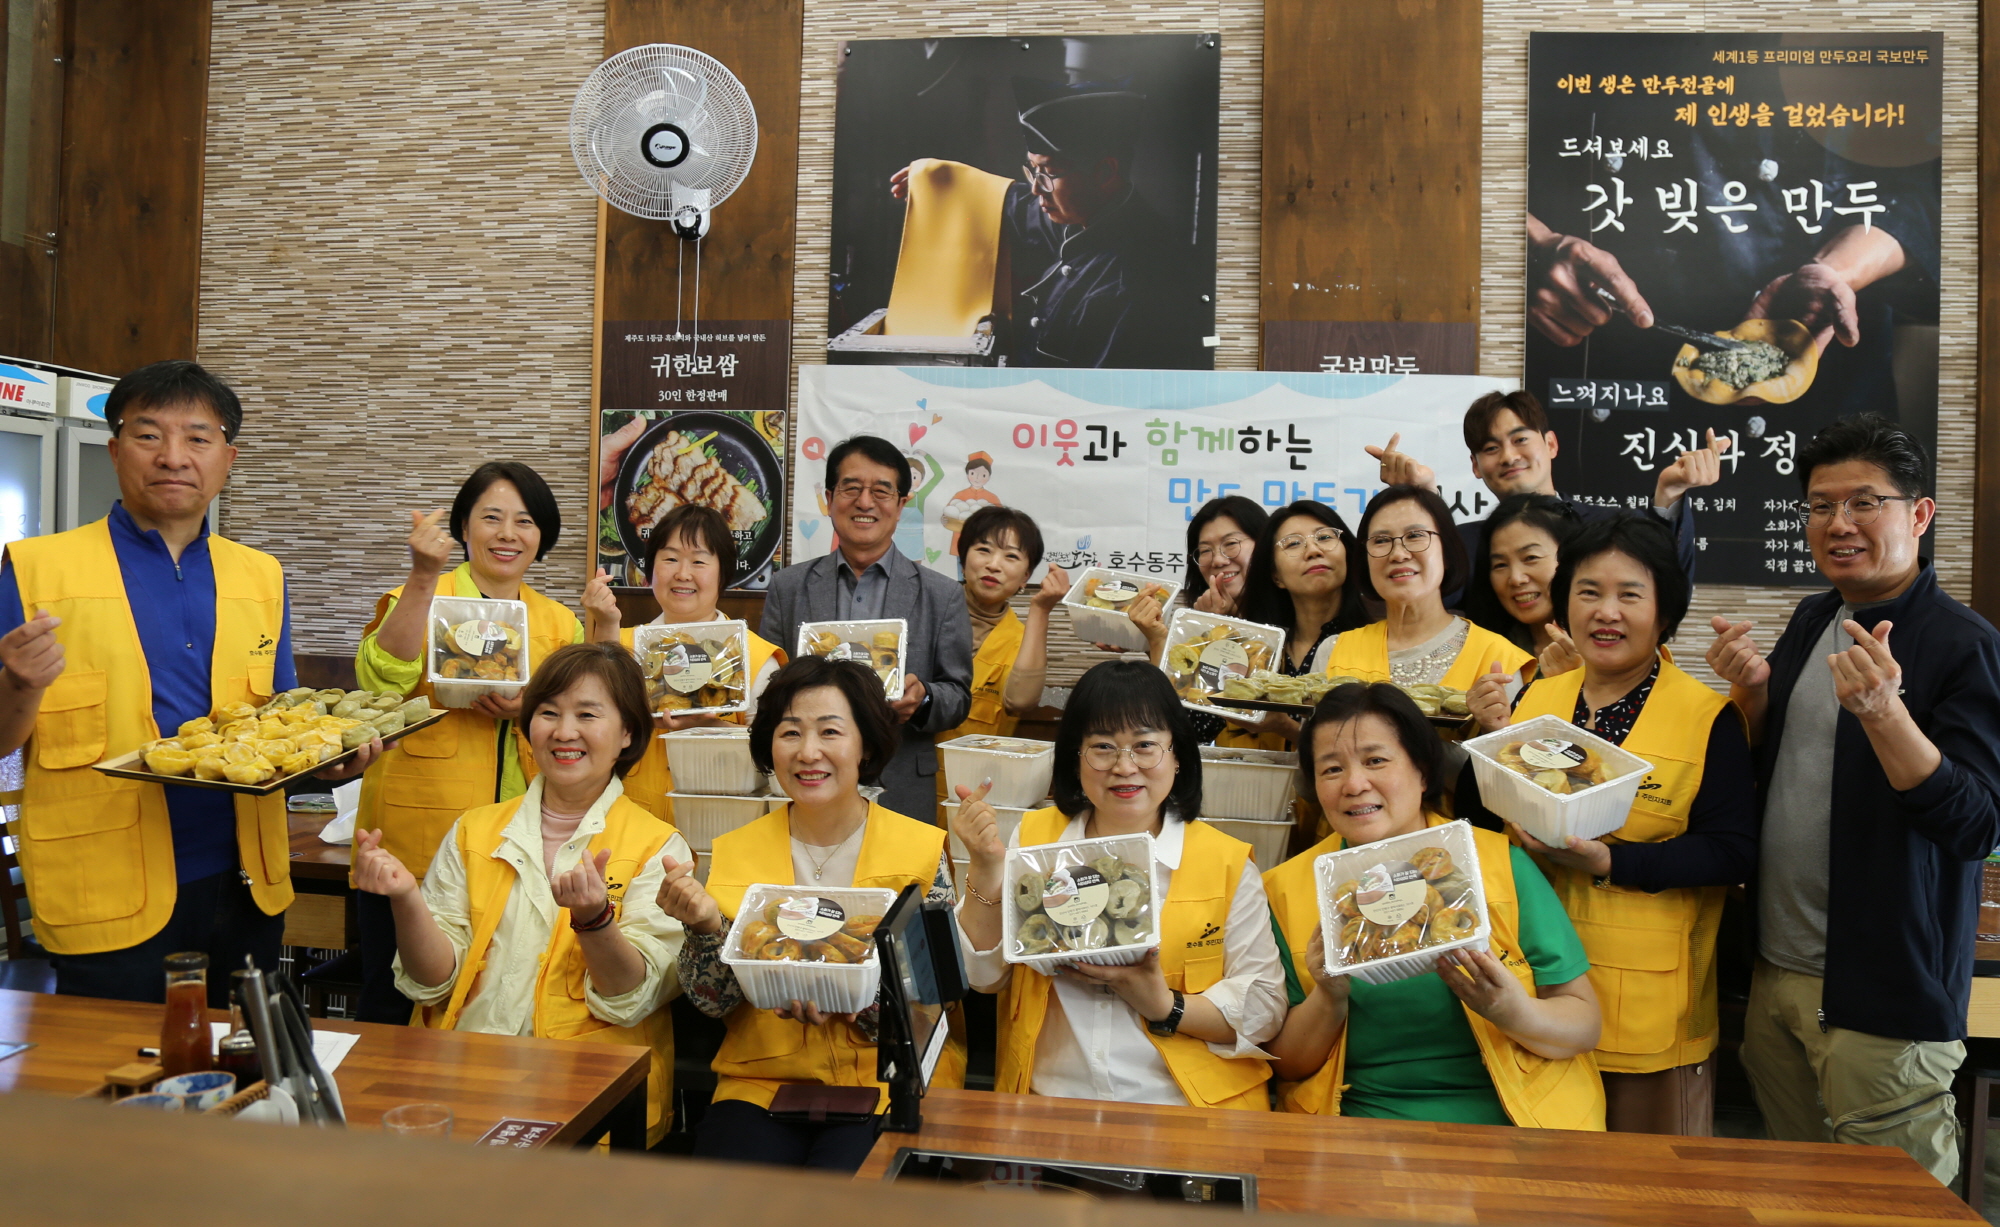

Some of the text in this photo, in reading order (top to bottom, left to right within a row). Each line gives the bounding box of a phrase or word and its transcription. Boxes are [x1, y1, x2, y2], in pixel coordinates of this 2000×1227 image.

[1712, 50, 1929, 64] 세계1등 프리미엄 만두요리 국보만두
[1557, 74, 1735, 96] 이번 생은 만두전골에
[1674, 101, 1905, 128] 제 인생을 걸었습니다!
[1558, 135, 1674, 161] 드셔보세요
[1582, 176, 1886, 236] 갓 빚은 만두
[650, 353, 739, 378] 귀한보쌈
[658, 389, 728, 402] 30인 한정판매
[1552, 381, 1668, 408] 느껴지나요
[1012, 417, 1313, 471] 이웃과 함께하는
[1713, 498, 1736, 512] 김치
[1764, 519, 1801, 533] 소화가
[1764, 538, 1789, 553] 자가
[1764, 558, 1788, 573] 직접
